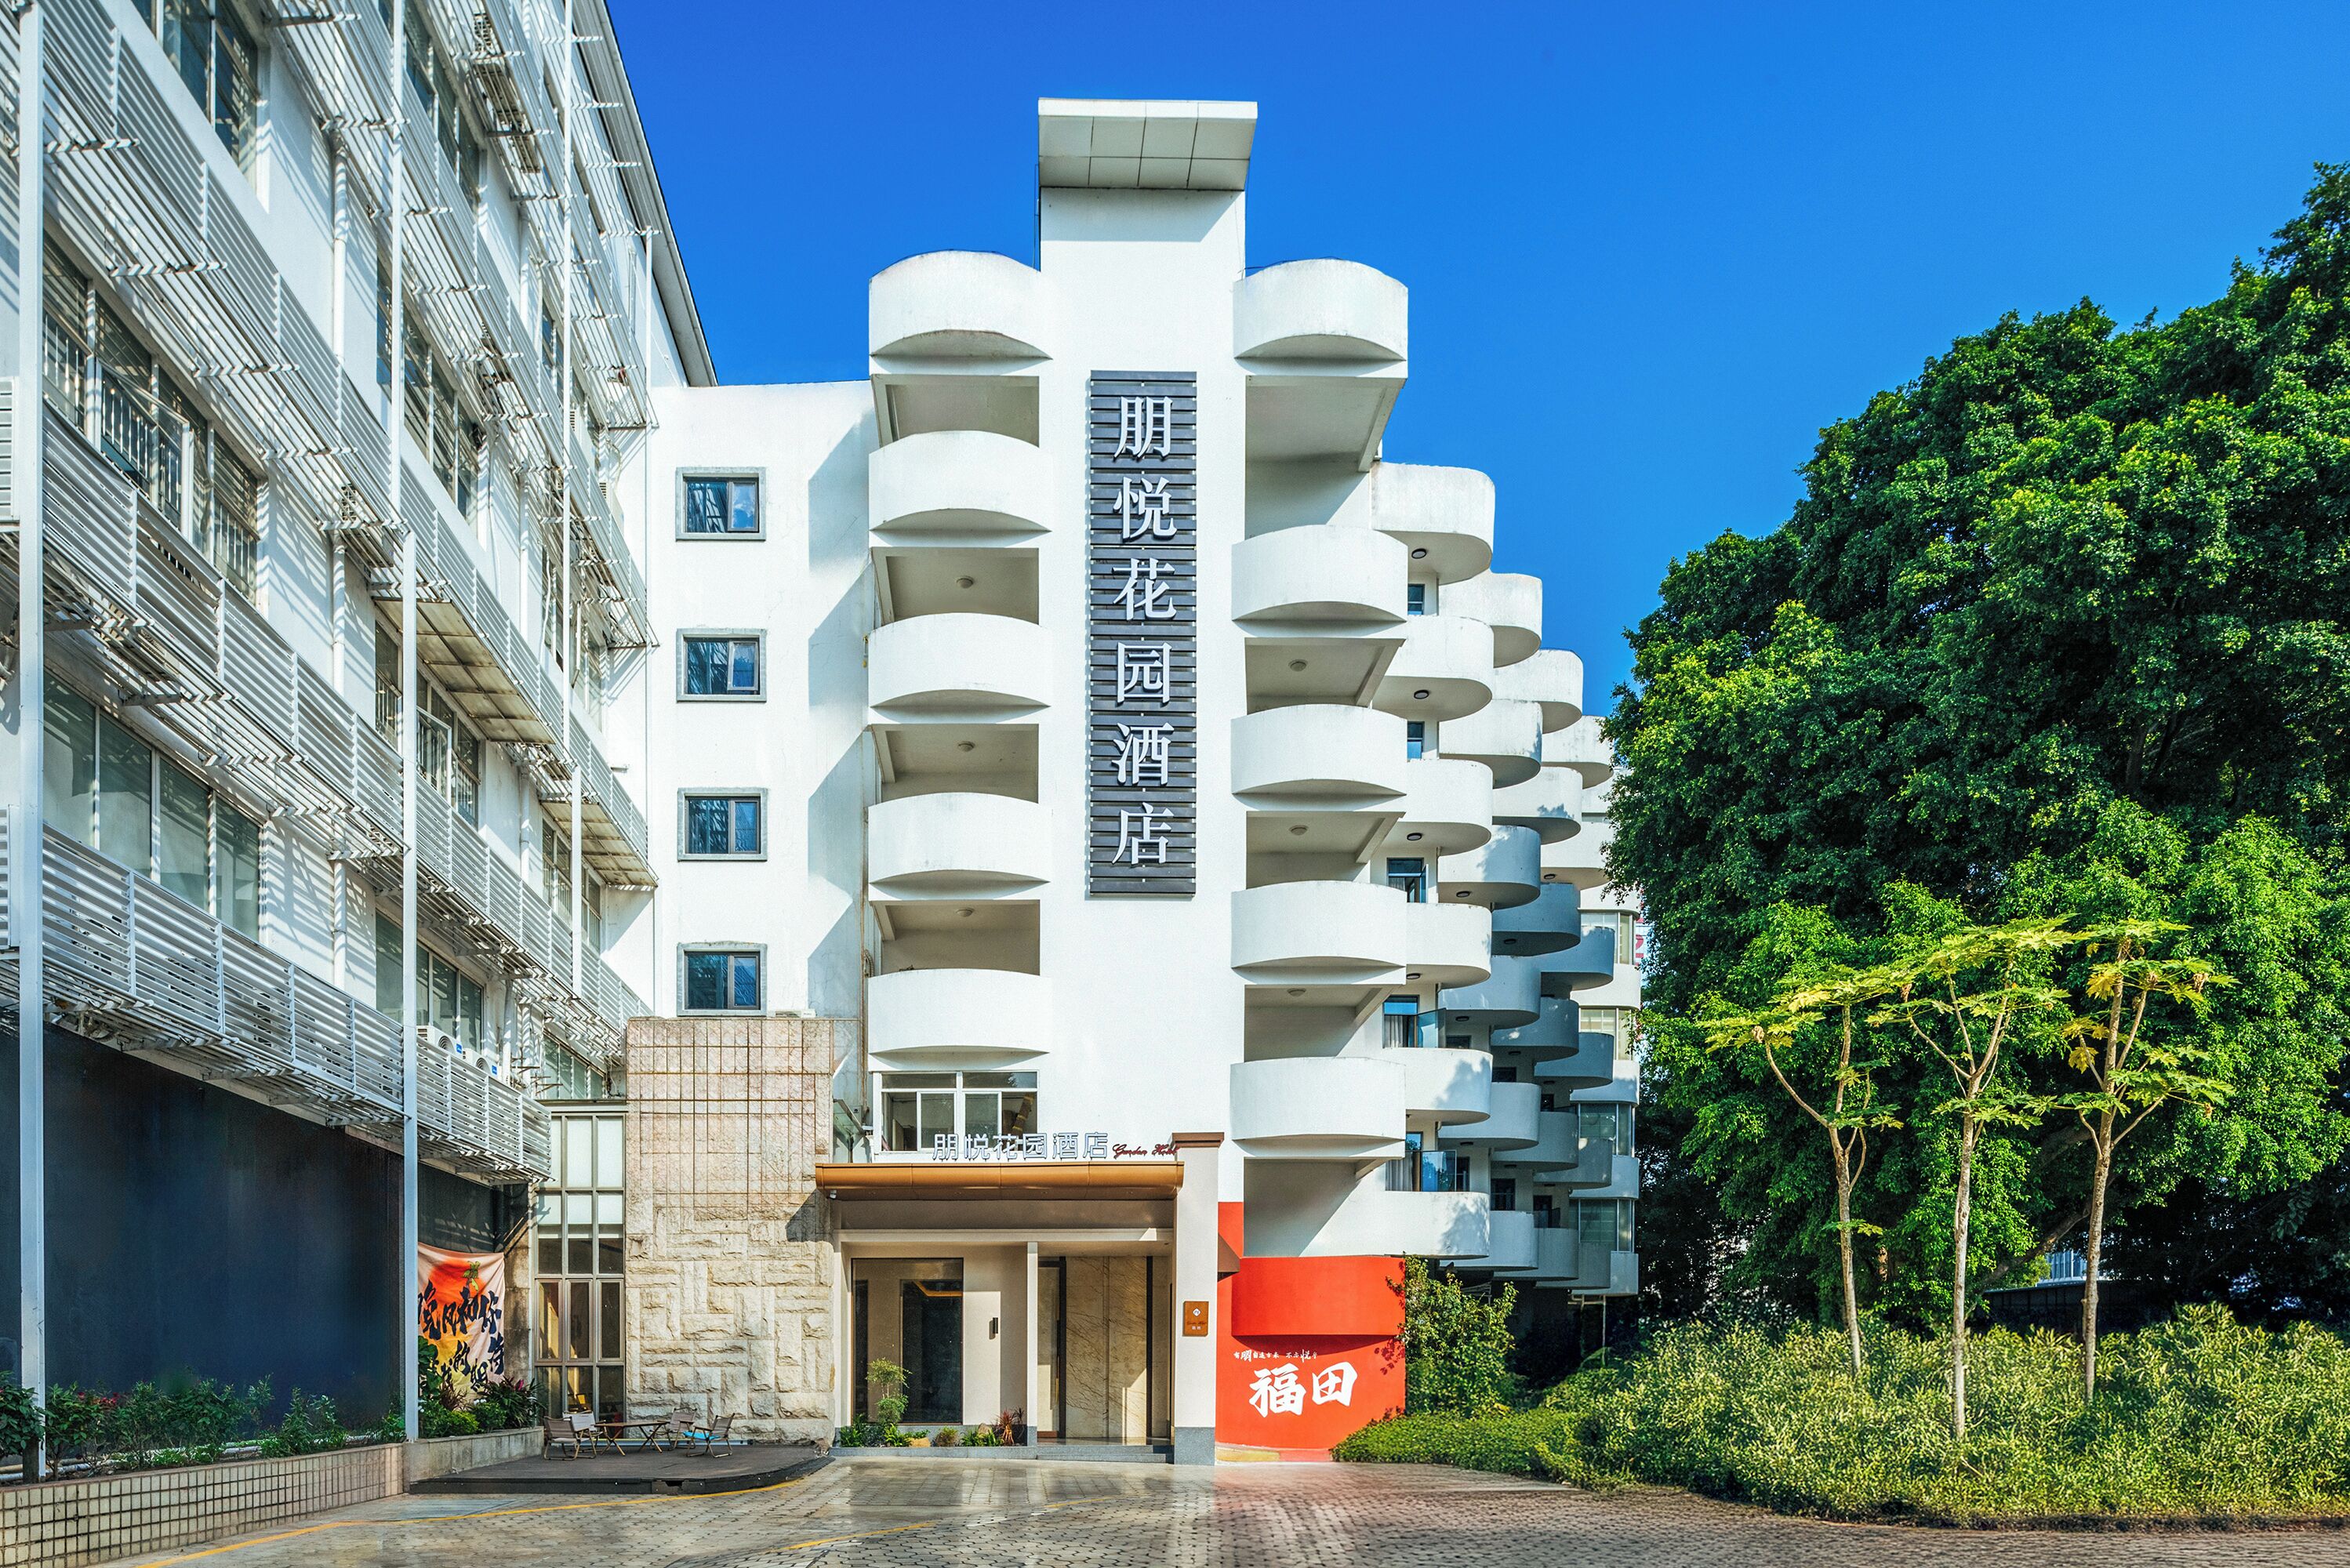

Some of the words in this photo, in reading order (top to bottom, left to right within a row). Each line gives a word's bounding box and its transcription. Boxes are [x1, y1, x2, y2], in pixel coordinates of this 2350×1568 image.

[1112, 395, 1177, 867] 朋悦花园酒店
[932, 1132, 1108, 1161] 朋悦花园酒店
[1112, 1143, 1148, 1160] Garden
[1151, 1143, 1180, 1156] Hotel
[1249, 1362, 1357, 1417] 福田
